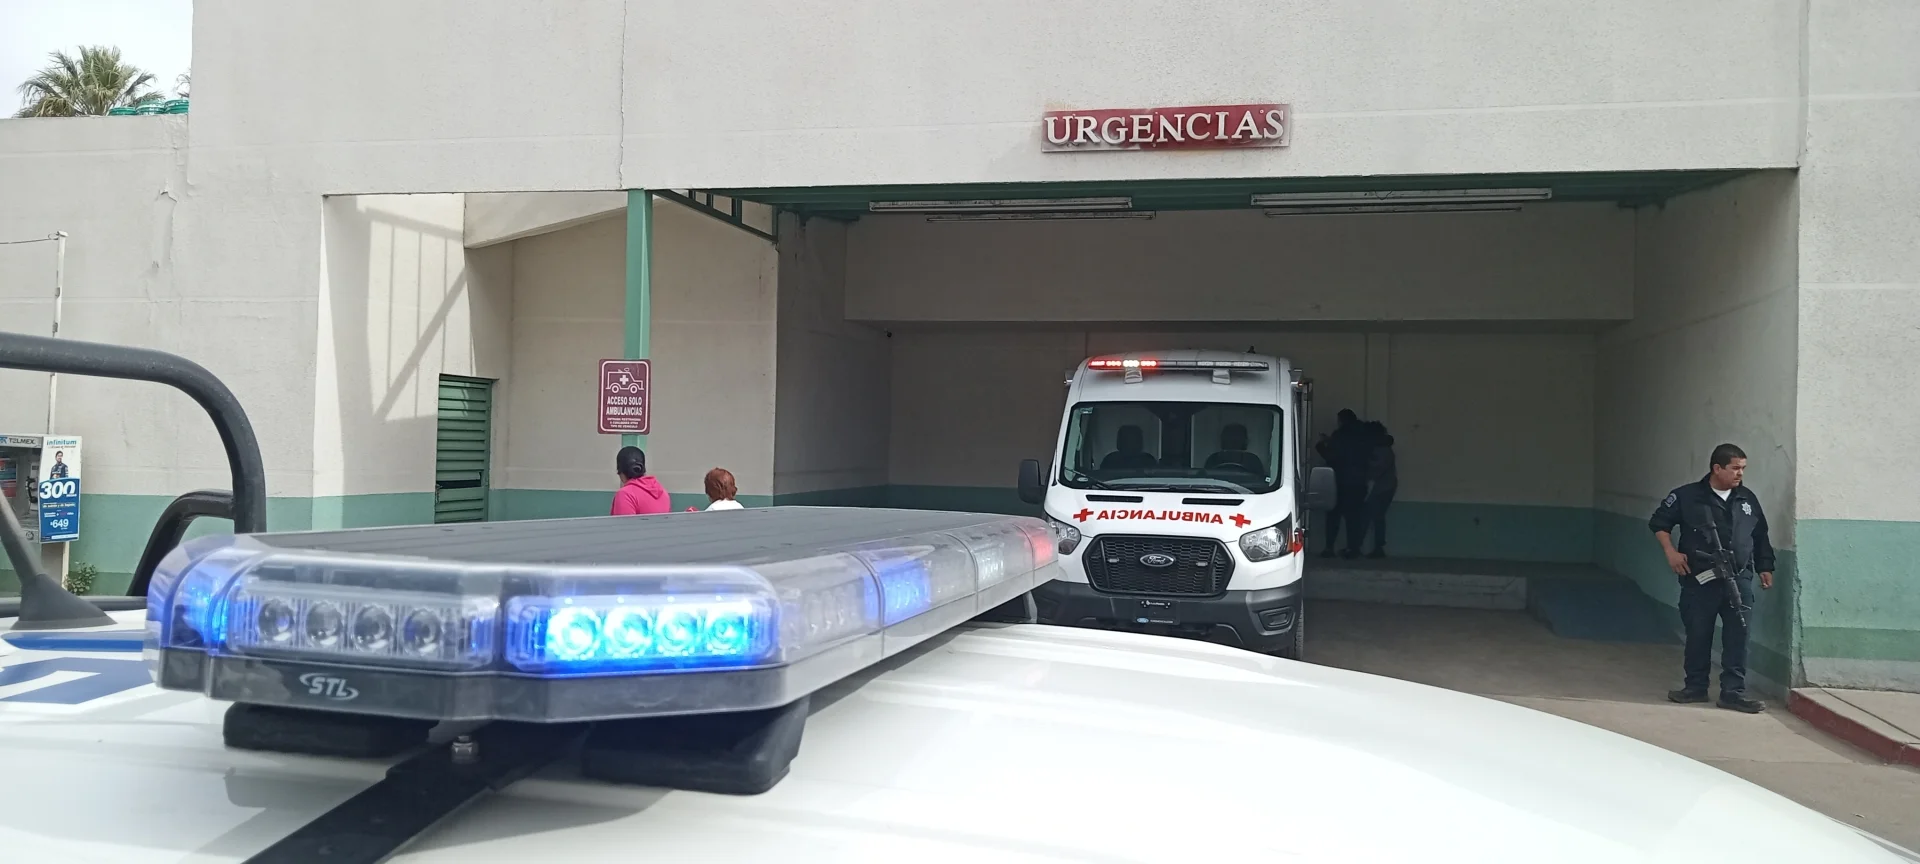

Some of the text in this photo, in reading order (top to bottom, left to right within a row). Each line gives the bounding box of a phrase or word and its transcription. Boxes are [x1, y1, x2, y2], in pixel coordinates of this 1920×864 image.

[1044, 110, 1284, 145] URGENCIAS
[607, 396, 642, 405] ACCESO SOLO
[606, 407, 642, 415] AMBULANCIAS
[40, 481, 76, 499] 300
[50, 519, 68, 528] $649
[308, 677, 348, 697] STL
